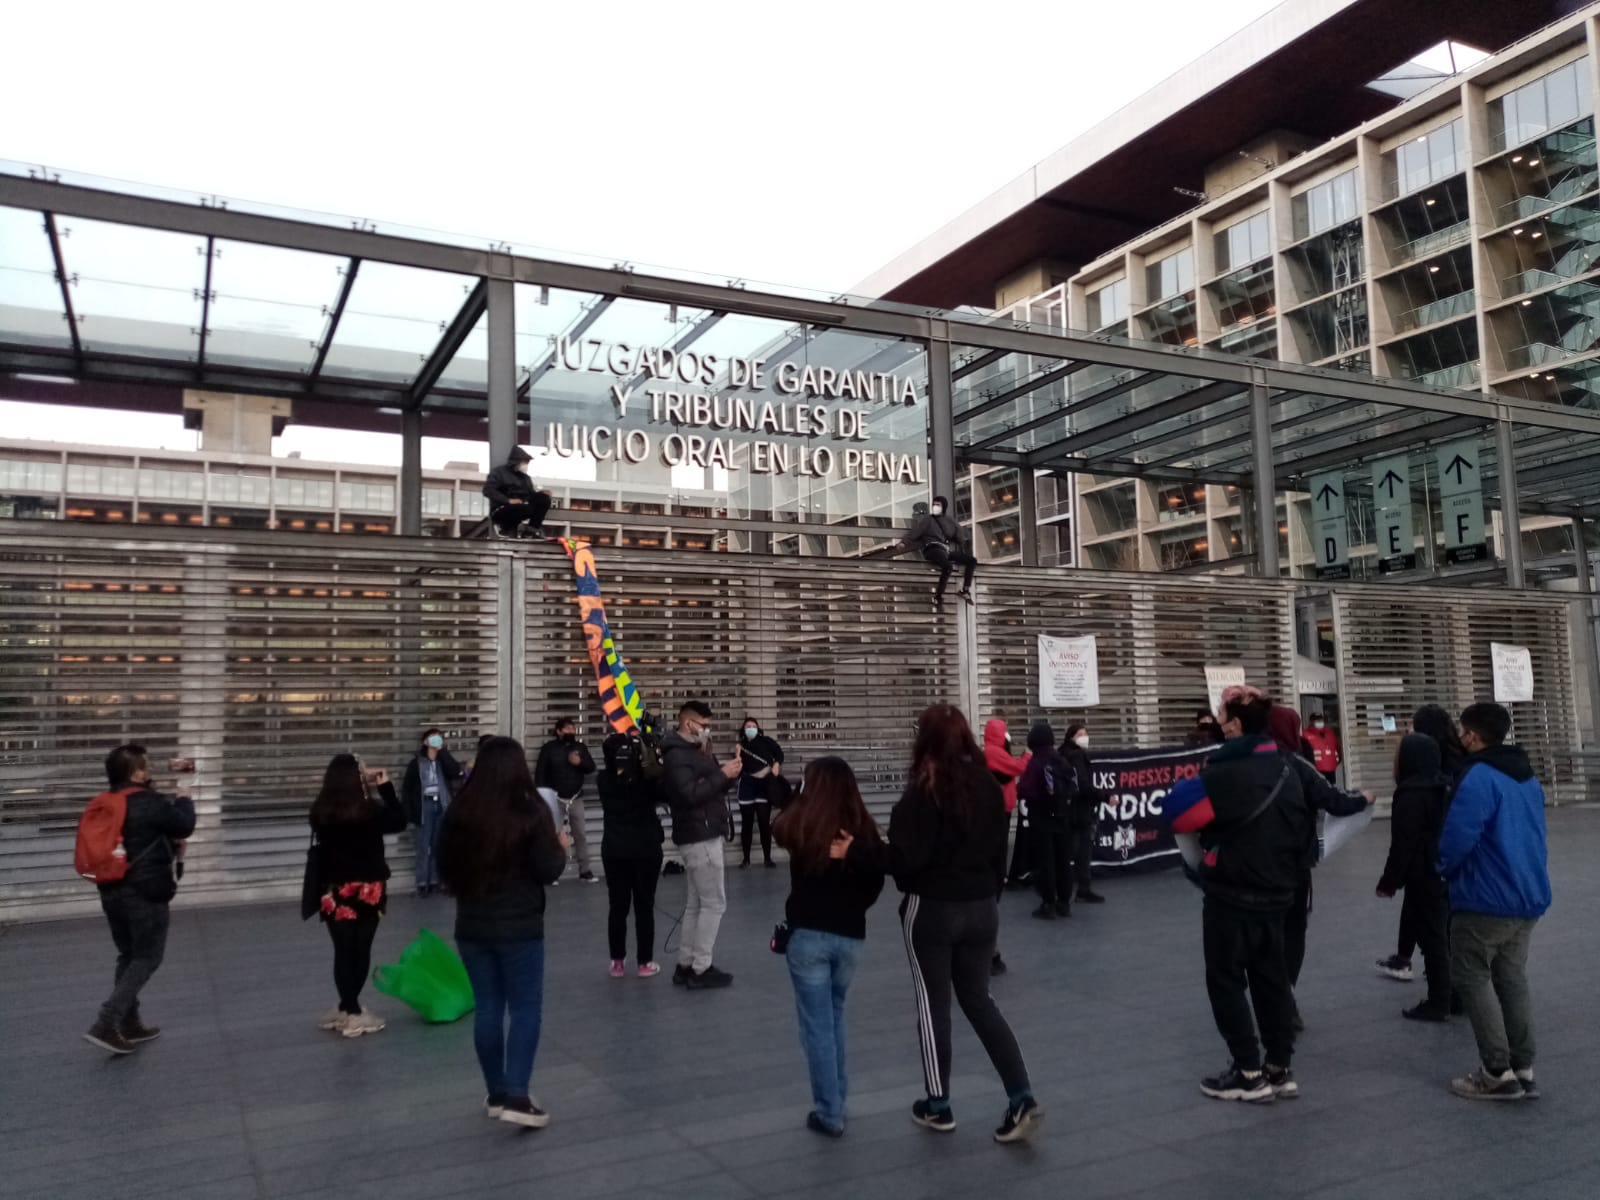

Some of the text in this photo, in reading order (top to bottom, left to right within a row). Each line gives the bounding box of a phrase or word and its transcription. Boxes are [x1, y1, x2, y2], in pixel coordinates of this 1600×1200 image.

[549, 335, 919, 405] JUZGADOS DE GARANTIA
[611, 384, 871, 440] Y TRIBUNALES DE
[544, 422, 927, 484] JUICIO ORAL EN LO PENAL
[1389, 525, 1401, 554] E
[1457, 513, 1469, 544] F
[1325, 537, 1336, 563] D
[1120, 767, 1171, 788] PRESXS
[1094, 788, 1172, 821] NDIC
